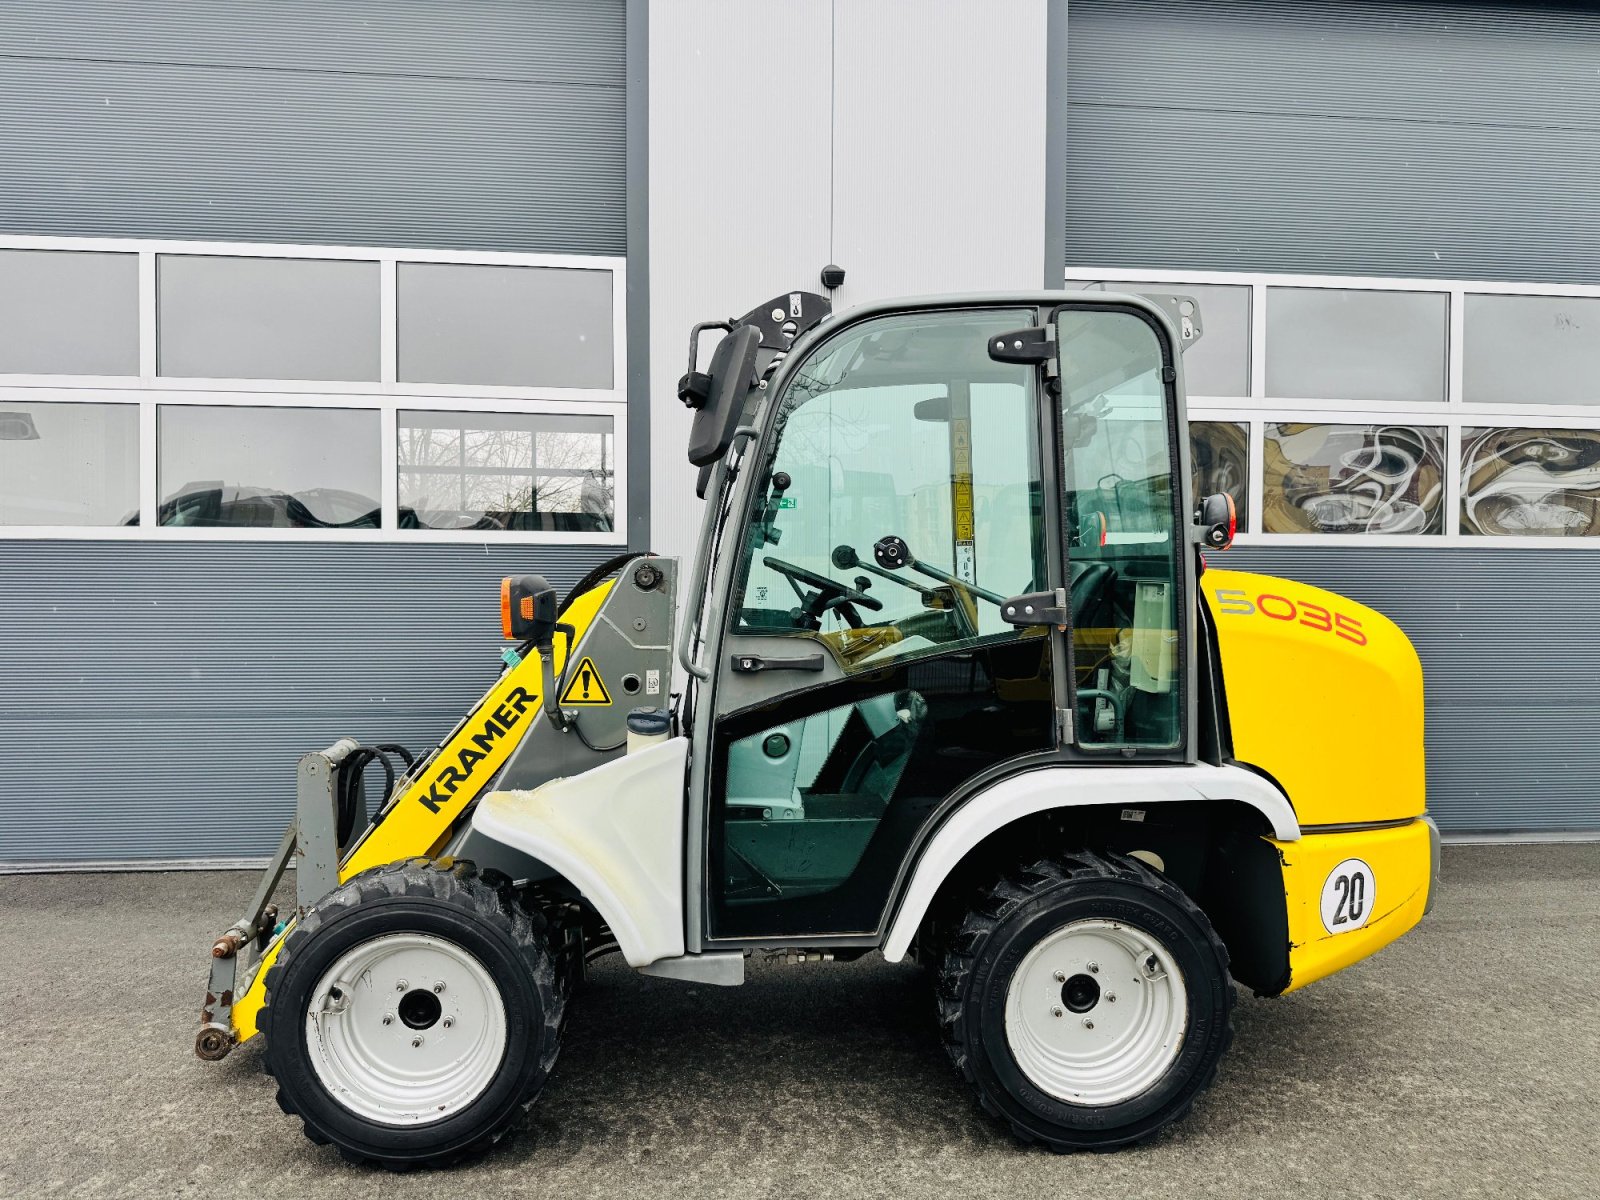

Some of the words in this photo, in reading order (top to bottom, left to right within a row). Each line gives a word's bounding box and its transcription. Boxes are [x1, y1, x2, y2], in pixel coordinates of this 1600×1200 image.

[1215, 589, 1367, 646] 5035
[419, 687, 538, 815] KRAMER
[1332, 871, 1365, 925] 20
